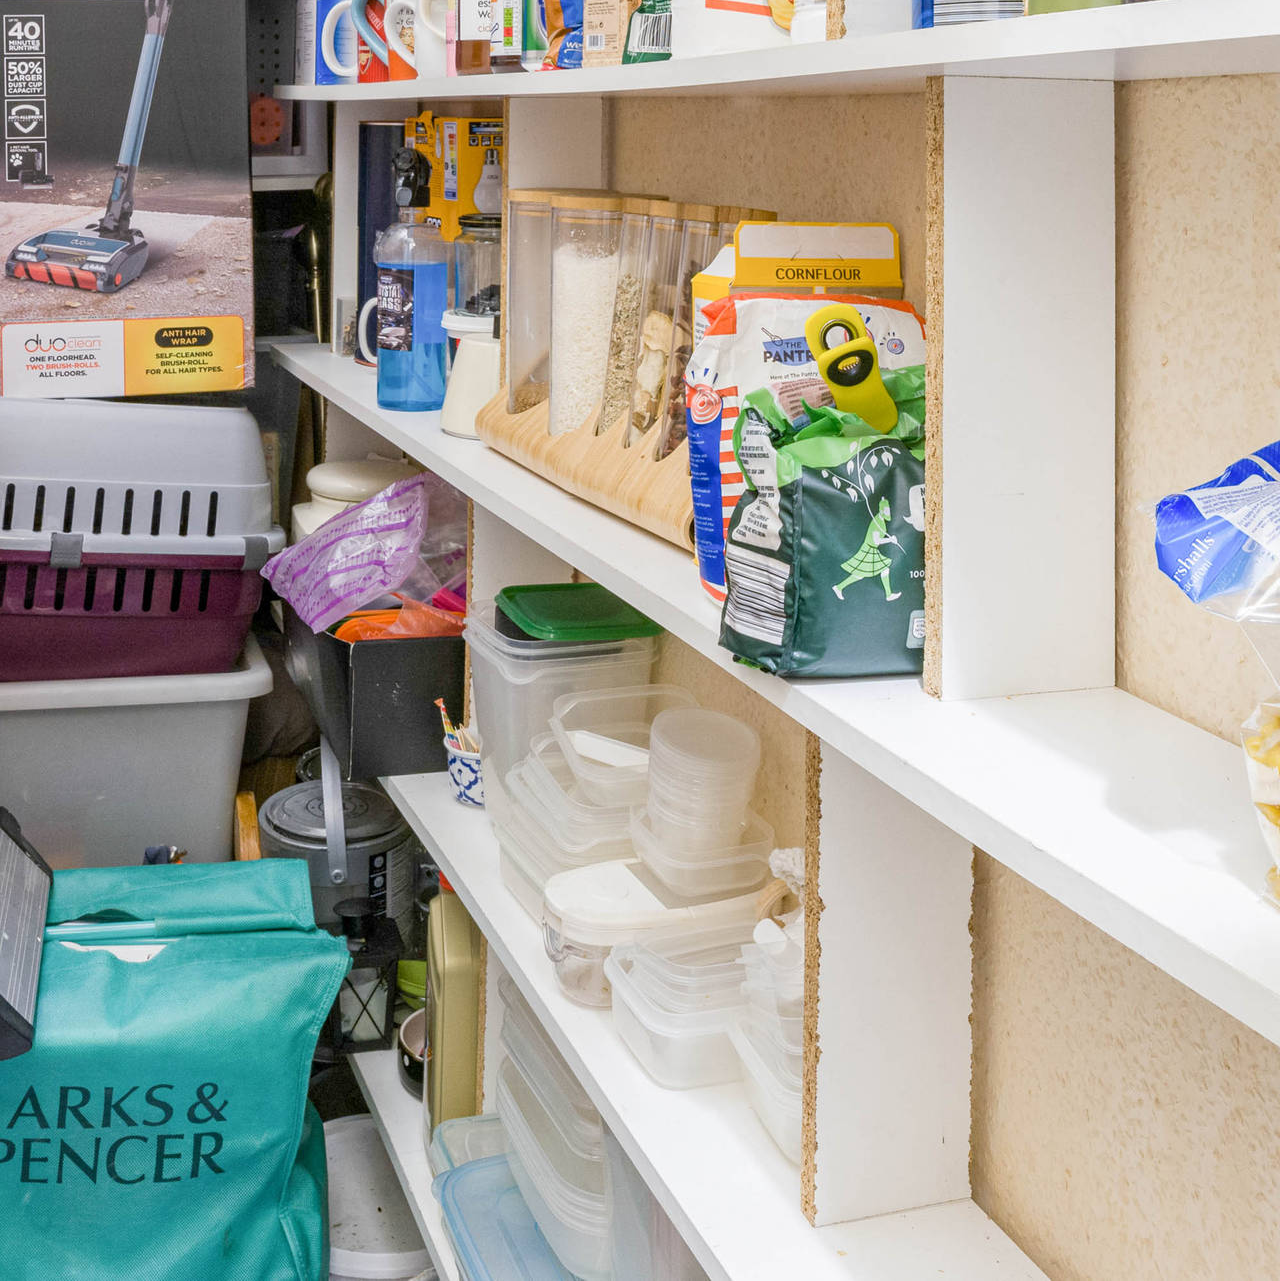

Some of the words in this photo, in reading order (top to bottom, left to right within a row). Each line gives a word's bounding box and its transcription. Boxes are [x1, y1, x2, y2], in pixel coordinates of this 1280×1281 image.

[8, 21, 41, 41] 40
[8, 61, 43, 76] 50%
[8, 74, 43, 82] LARGER
[775, 268, 862, 281] CORNFLOUR
[161, 328, 184, 339] ANTI
[185, 328, 207, 338] HAIR
[170, 336, 199, 346] WRAP
[784, 341, 802, 349] THE
[48, 354, 97, 362] FLOORHEAD.
[155, 350, 214, 359] SELF-CLEANING
[55, 369, 88, 378] FLOORS.
[186, 1082, 230, 1124] &
